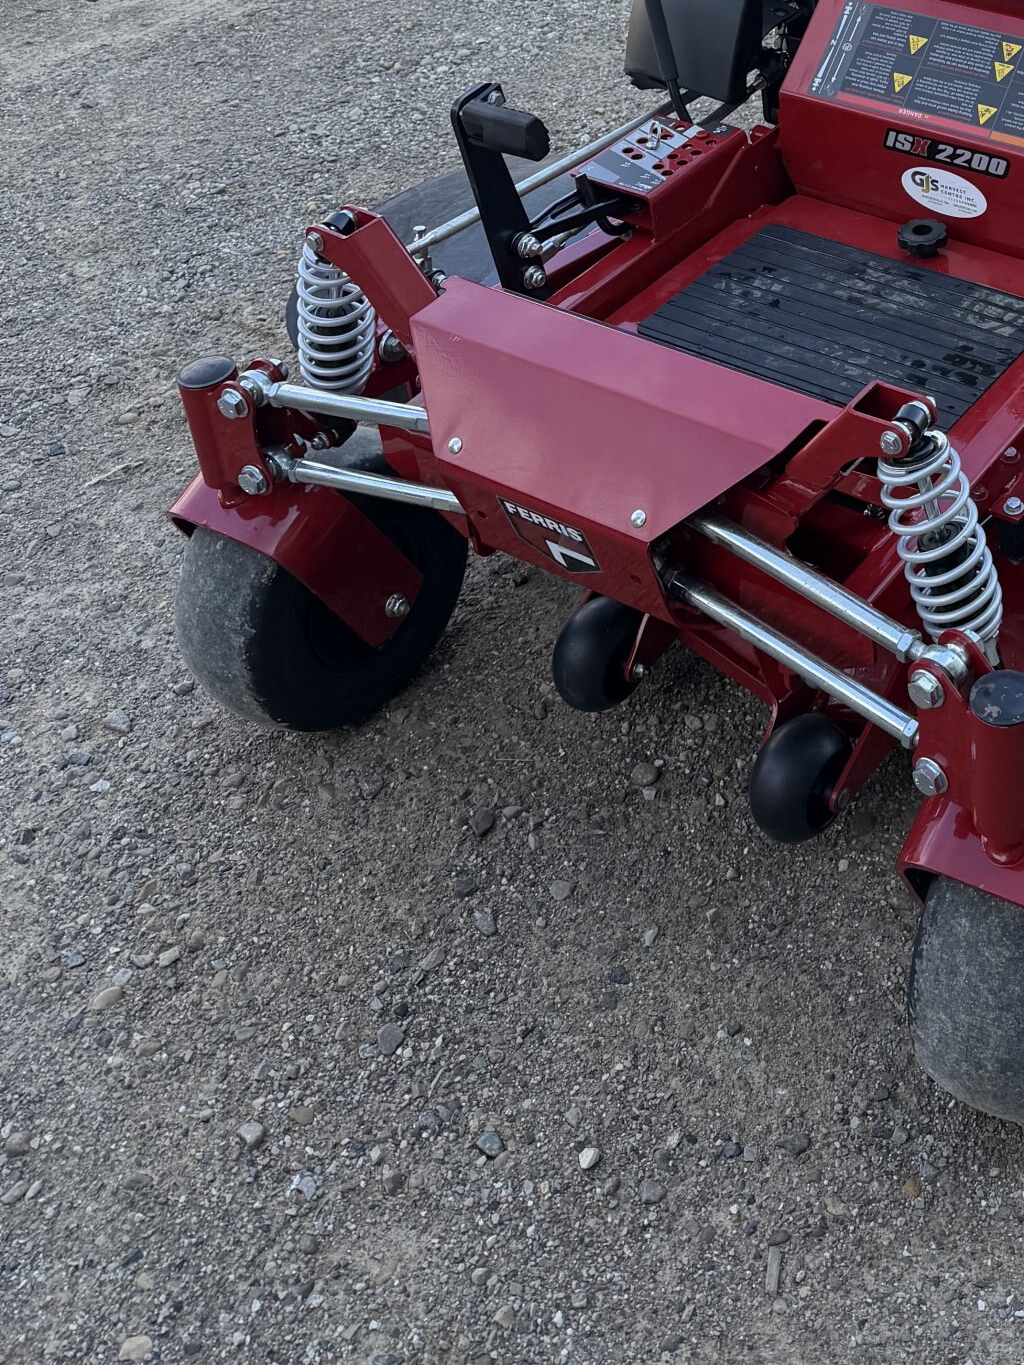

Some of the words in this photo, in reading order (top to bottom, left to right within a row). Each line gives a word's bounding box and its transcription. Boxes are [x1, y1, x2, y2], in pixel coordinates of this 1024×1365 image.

[898, 107, 923, 119] DANGER
[886, 131, 930, 156] ISX
[936, 144, 1008, 176] 2200
[940, 184, 966, 195] HARVEST
[940, 190, 962, 199] CENTRE
[964, 196, 977, 204] INC.
[503, 501, 583, 542] FERRIS
